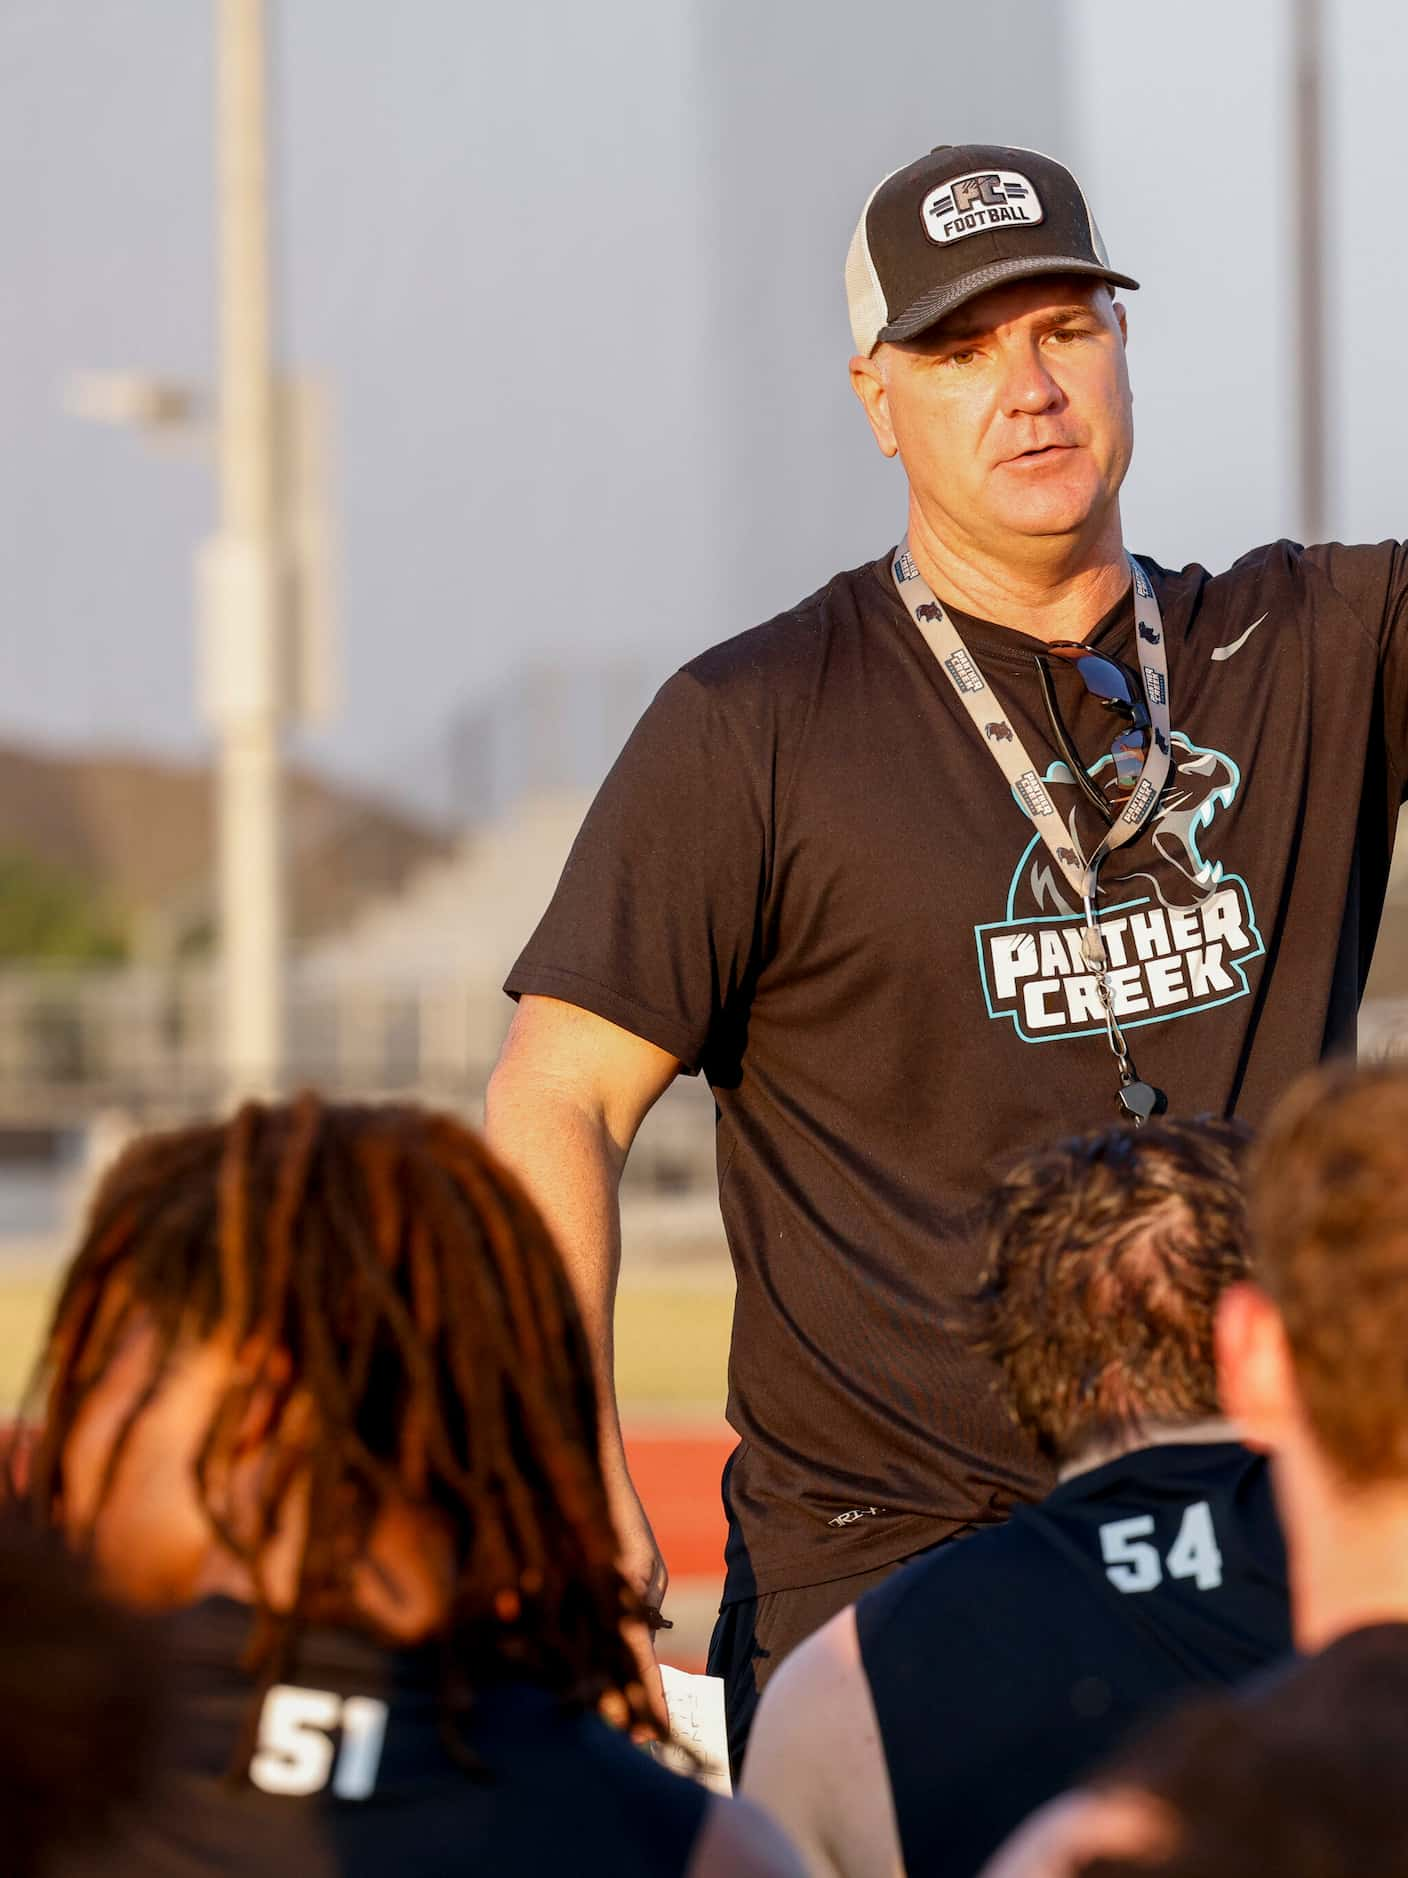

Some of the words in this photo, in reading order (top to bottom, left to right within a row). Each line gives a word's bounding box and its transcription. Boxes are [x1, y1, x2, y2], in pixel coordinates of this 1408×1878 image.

[944, 206, 1030, 237] FOOTBALL
[950, 657, 974, 689] CREEK
[953, 650, 983, 690] PANTHER
[1020, 779, 1043, 813] CREEK
[1023, 772, 1053, 815] PANTHER
[1123, 780, 1151, 822] PANTHER
[1130, 787, 1153, 821] CREEK
[990, 889, 1250, 999] PANTHER
[1023, 944, 1233, 1029] CREEK
[1099, 1501, 1223, 1594] 54
[248, 1684, 389, 1800] 51
